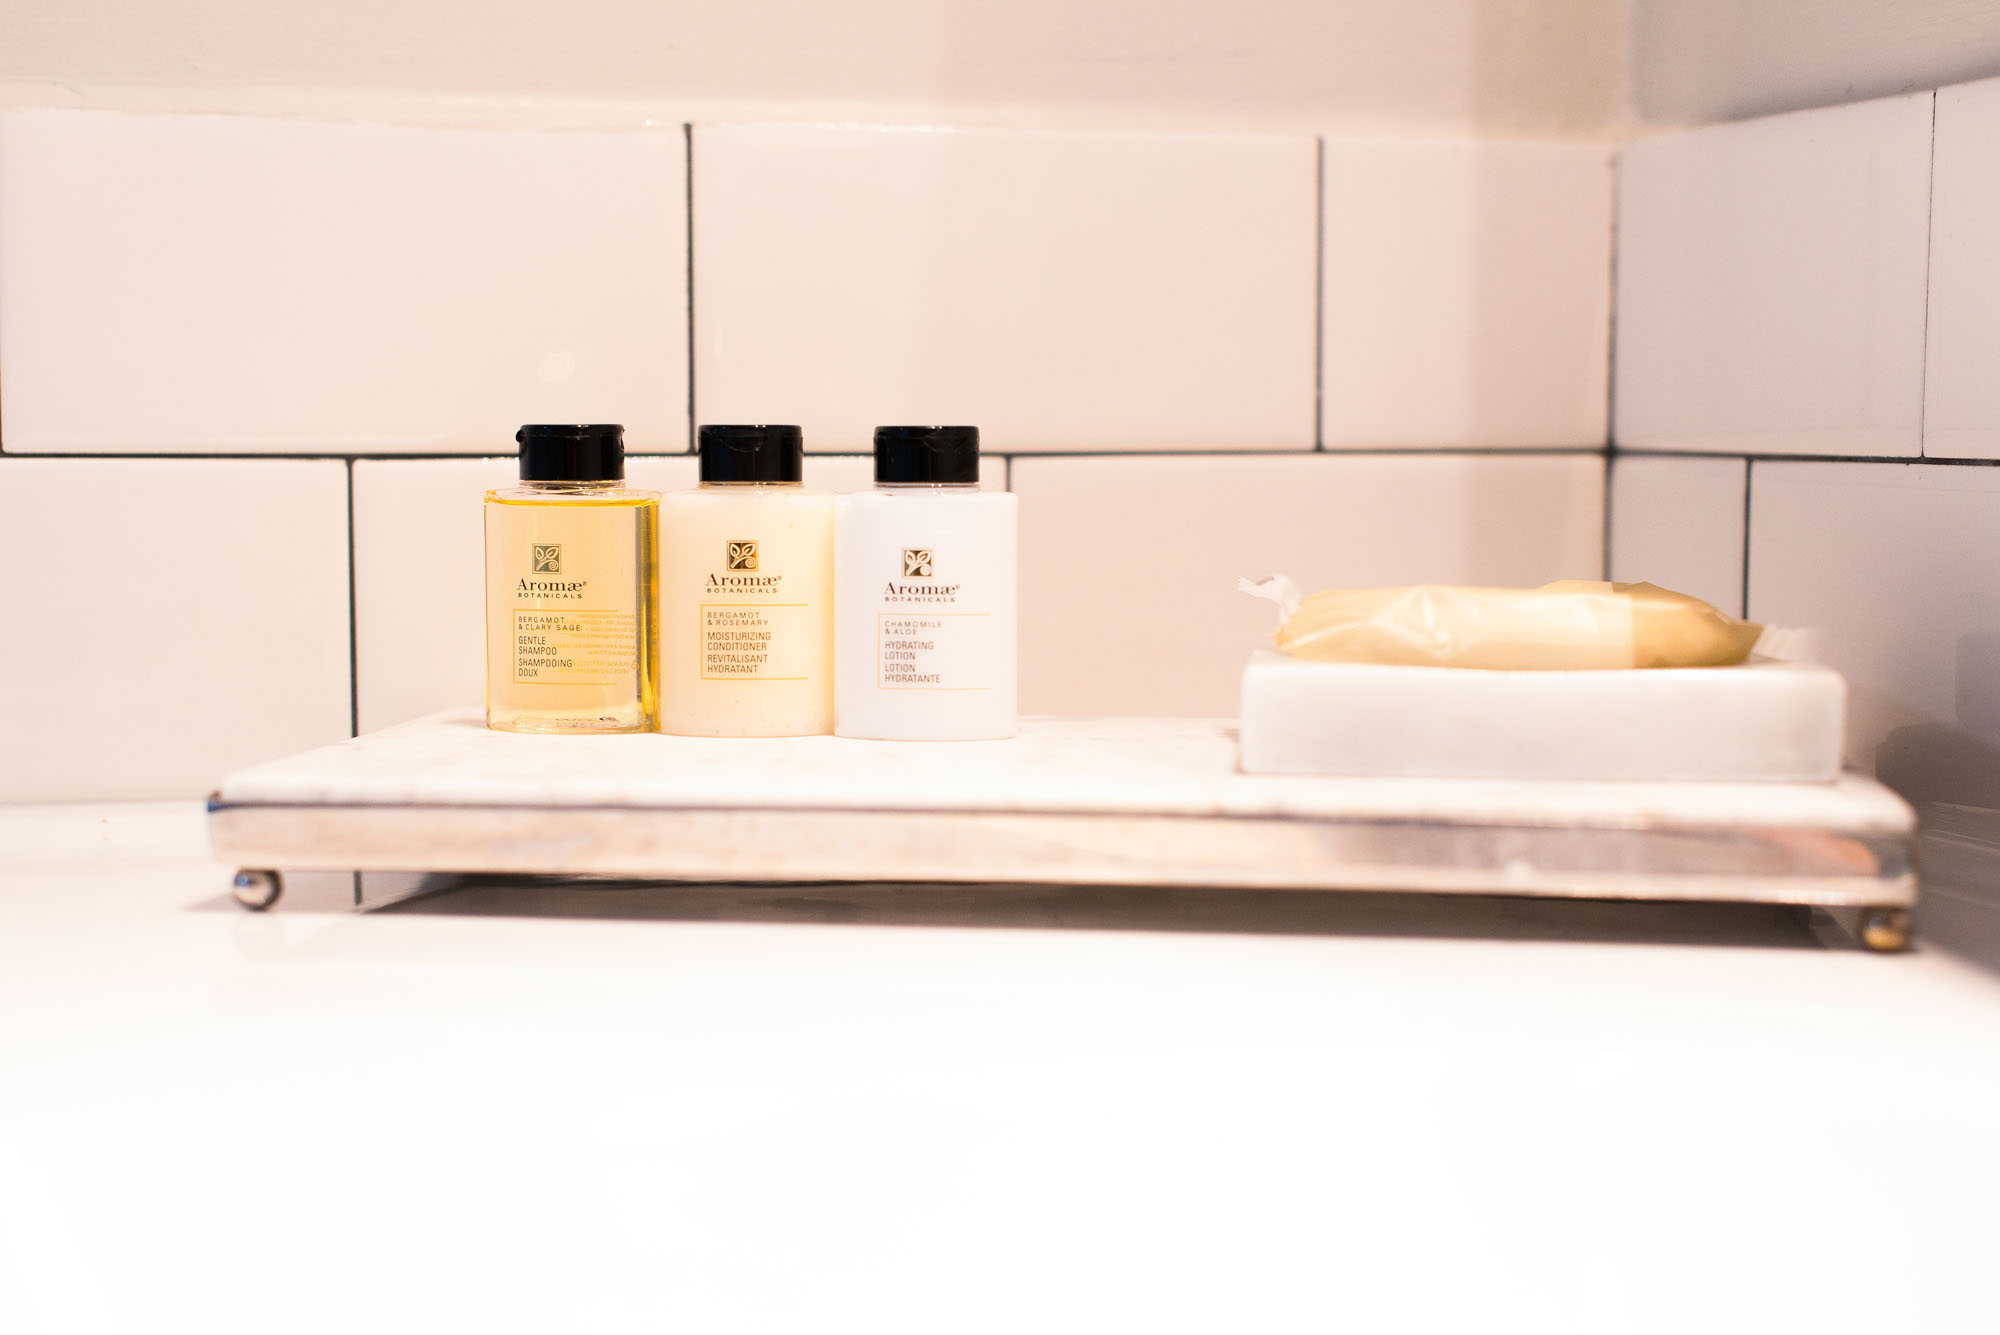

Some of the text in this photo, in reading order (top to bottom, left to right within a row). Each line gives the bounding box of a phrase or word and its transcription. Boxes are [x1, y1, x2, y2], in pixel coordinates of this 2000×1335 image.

[518, 636, 546, 645] GENTLE
[707, 632, 771, 641] MOISTURIZING
[707, 642, 767, 651] CONDITIONER
[884, 641, 934, 650] HYDRATING
[518, 646, 557, 655] SHAMPOO
[707, 654, 768, 663] REVITALISANT
[884, 651, 916, 660] LOTION
[518, 658, 573, 668] SHAMPOOING
[884, 663, 916, 672] LOTION
[518, 668, 539, 677] DOUX
[707, 664, 758, 673] HYDRATANT
[884, 674, 941, 683] HYDRATANTE
